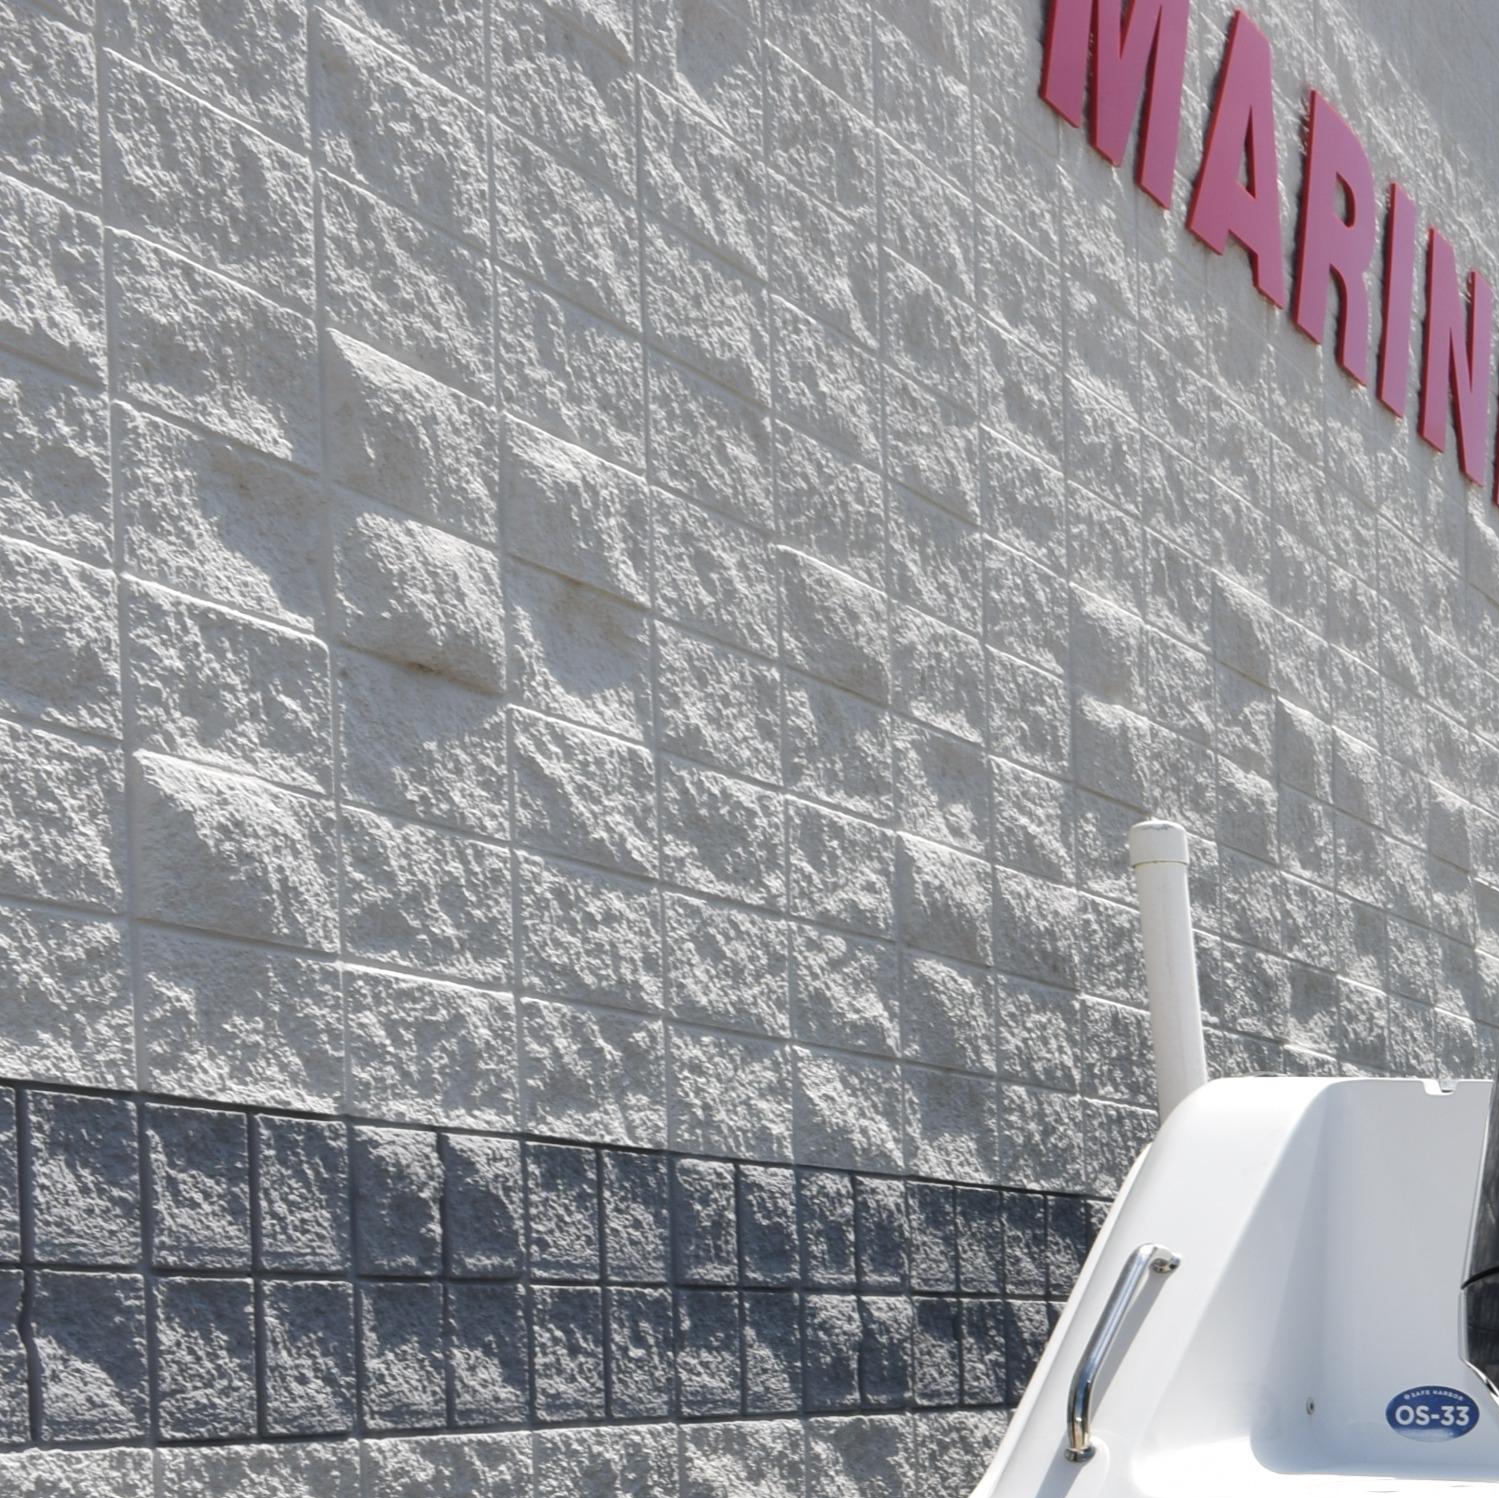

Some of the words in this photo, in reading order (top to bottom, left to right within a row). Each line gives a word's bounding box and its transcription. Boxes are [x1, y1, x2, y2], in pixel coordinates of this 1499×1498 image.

[1411, 1389, 1431, 1398] SAFE
[1432, 1389, 1464, 1401] HARBOR
[1395, 1405, 1470, 1426] OS-33
